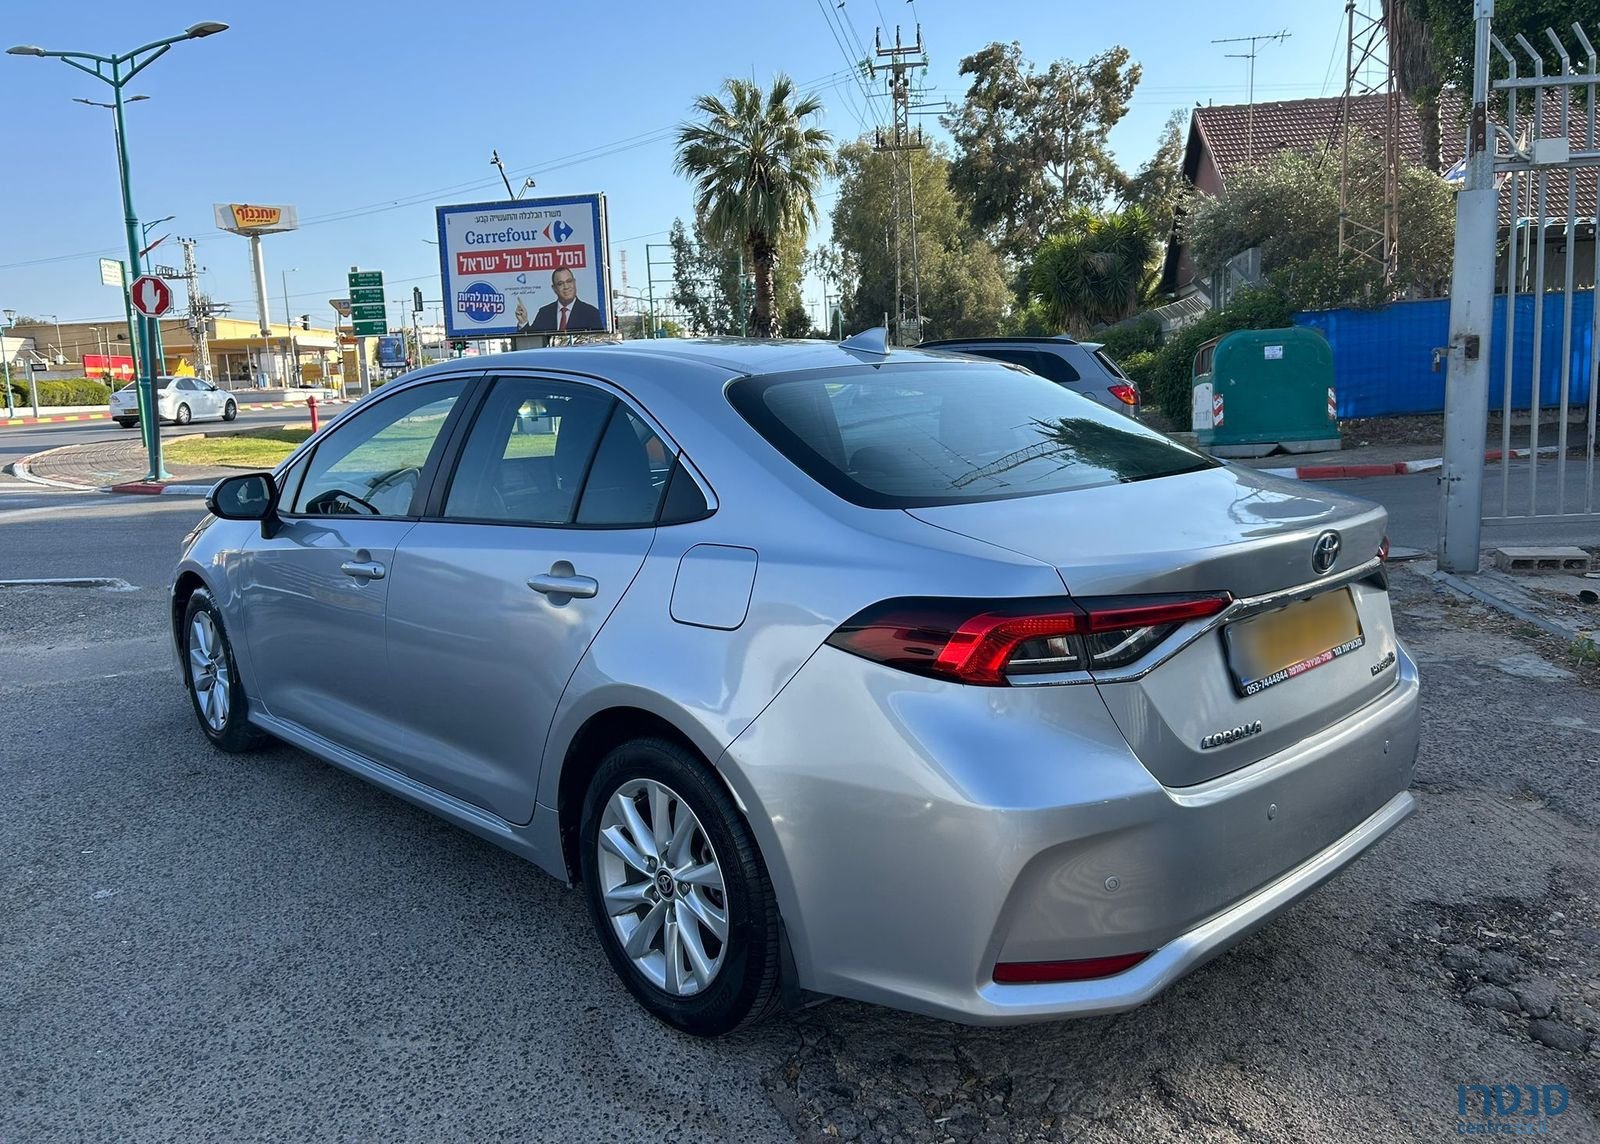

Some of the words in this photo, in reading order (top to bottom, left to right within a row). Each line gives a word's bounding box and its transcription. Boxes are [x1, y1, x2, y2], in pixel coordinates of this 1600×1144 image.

[236, 208, 276, 221] יוחננוף
[489, 213, 518, 222] והתעשייה
[519, 211, 542, 220] הכלכלה
[543, 210, 562, 218] משרד
[465, 227, 538, 245] Carrefour
[460, 255, 499, 272] ישראל
[503, 253, 522, 270] של
[526, 251, 553, 268] הזול
[556, 249, 583, 266] הסל
[458, 291, 481, 302] להיות
[482, 293, 504, 303] גמרנו
[458, 302, 504, 313] פראיירים
[1246, 669, 1289, 695] 053-7444844
[1200, 719, 1262, 750] COROLLA
